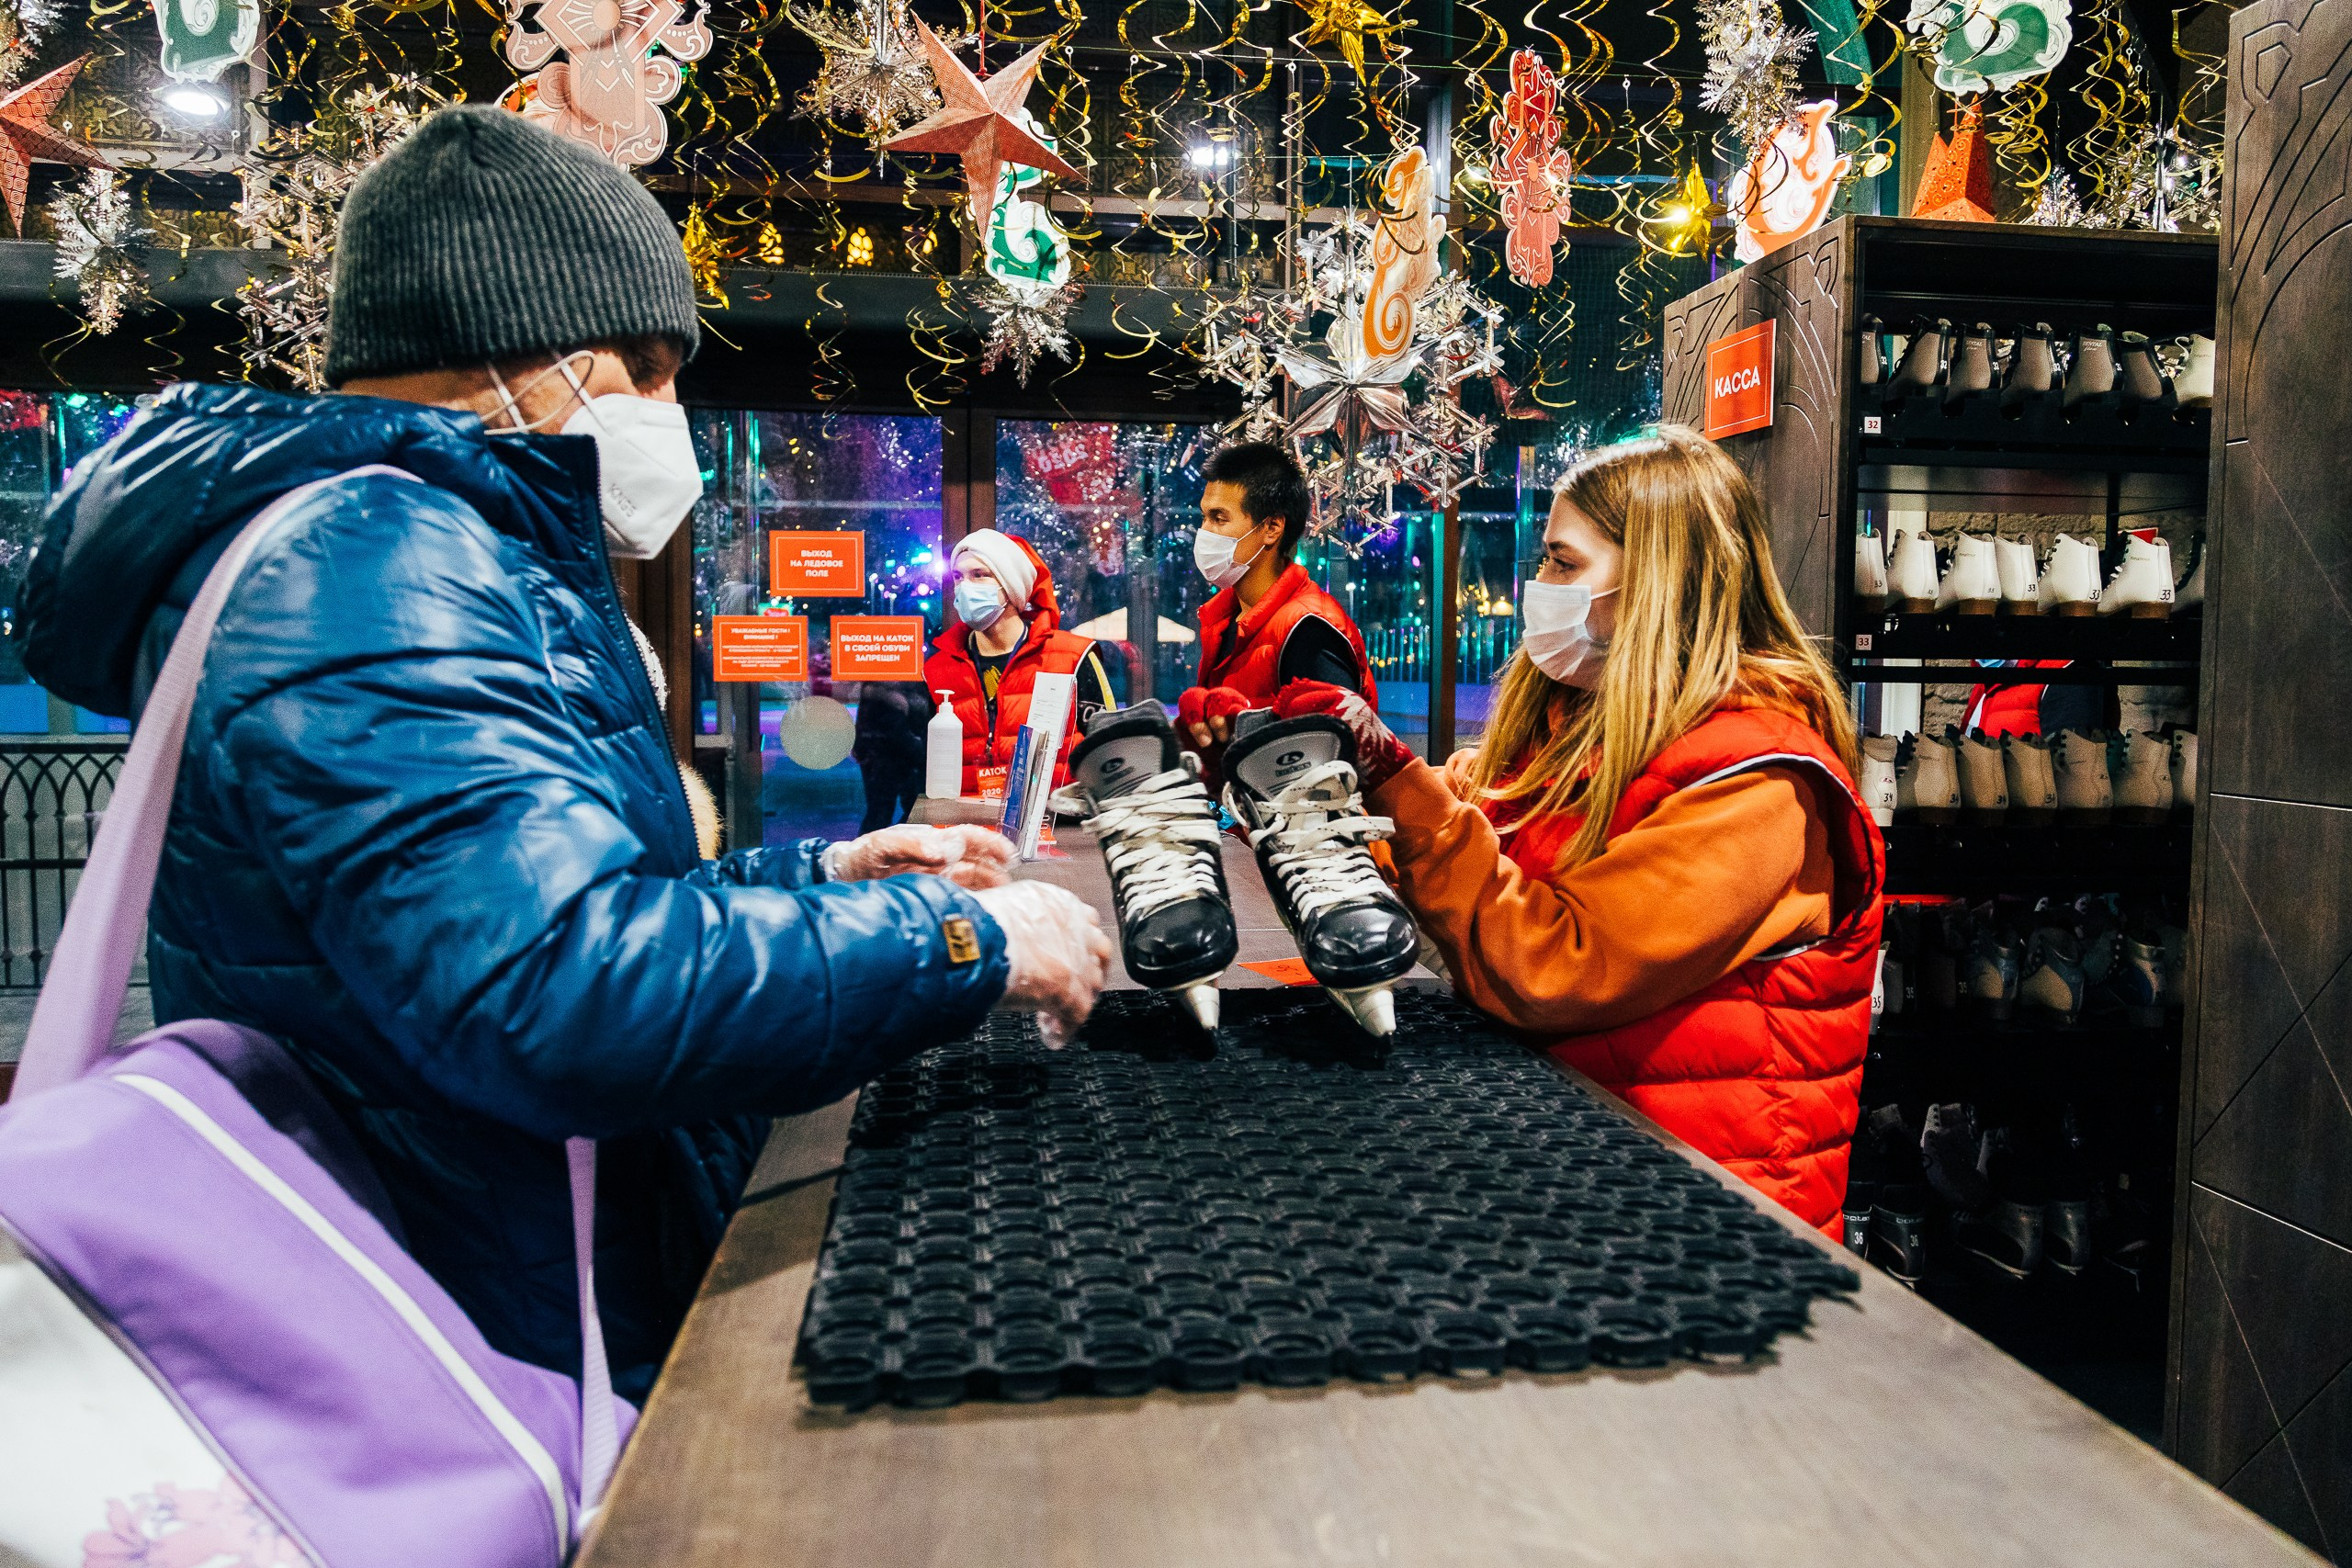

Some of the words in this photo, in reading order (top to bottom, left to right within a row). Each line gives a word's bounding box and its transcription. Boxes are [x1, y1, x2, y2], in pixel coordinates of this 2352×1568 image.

[1714, 365, 1760, 400] КАССА
[1868, 420, 1878, 429] 32
[800, 549, 832, 558] ВЫХОД
[804, 559, 843, 568] ЛЕДОВОЕ
[2028, 584, 2036, 592] 33
[2089, 589, 2101, 600] 33
[2160, 589, 2171, 601] 33
[1859, 637, 1870, 646] 33
[852, 643, 880, 651] СВОЕЙ
[978, 766, 1007, 777] КАТОК
[1883, 793, 1894, 802] 34
[1872, 996, 1882, 1009] 35
[1854, 1231, 1863, 1245] 36
